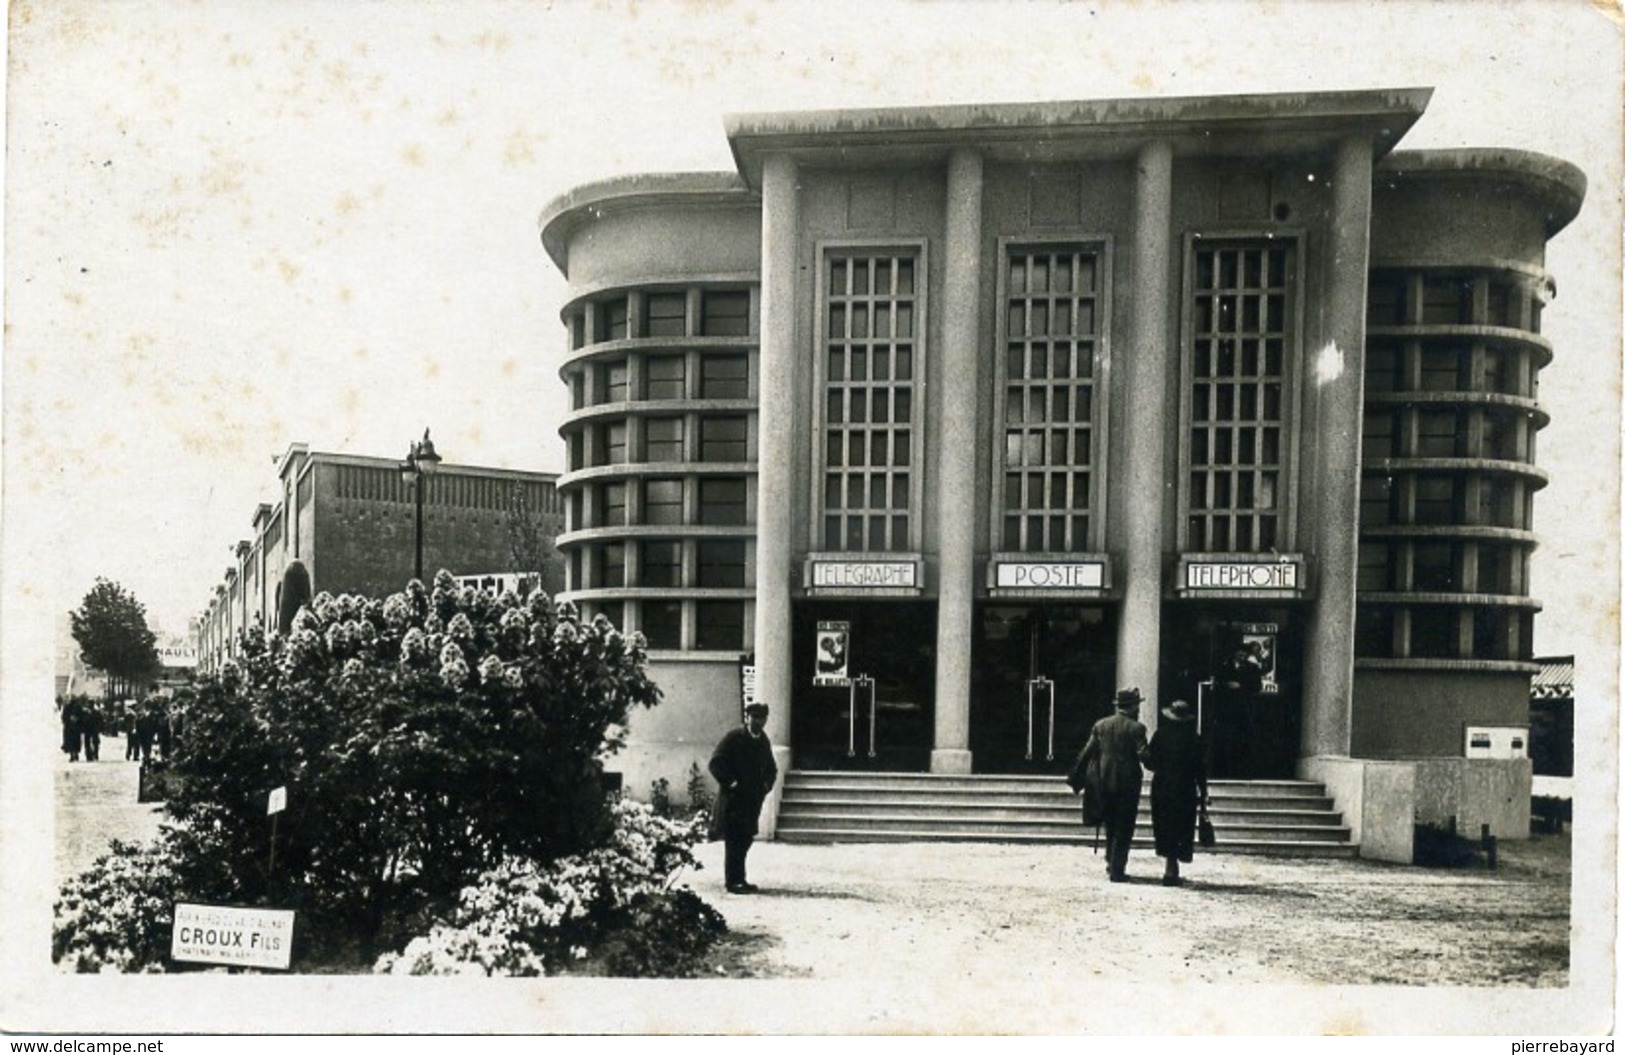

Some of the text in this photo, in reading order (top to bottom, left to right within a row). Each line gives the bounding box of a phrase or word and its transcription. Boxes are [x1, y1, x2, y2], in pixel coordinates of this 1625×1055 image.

[815, 564, 911, 584] TELEGRAPHE
[1014, 565, 1084, 586] POSTE
[1190, 565, 1292, 586] TELEPHONE
[180, 927, 243, 947] CROUX
